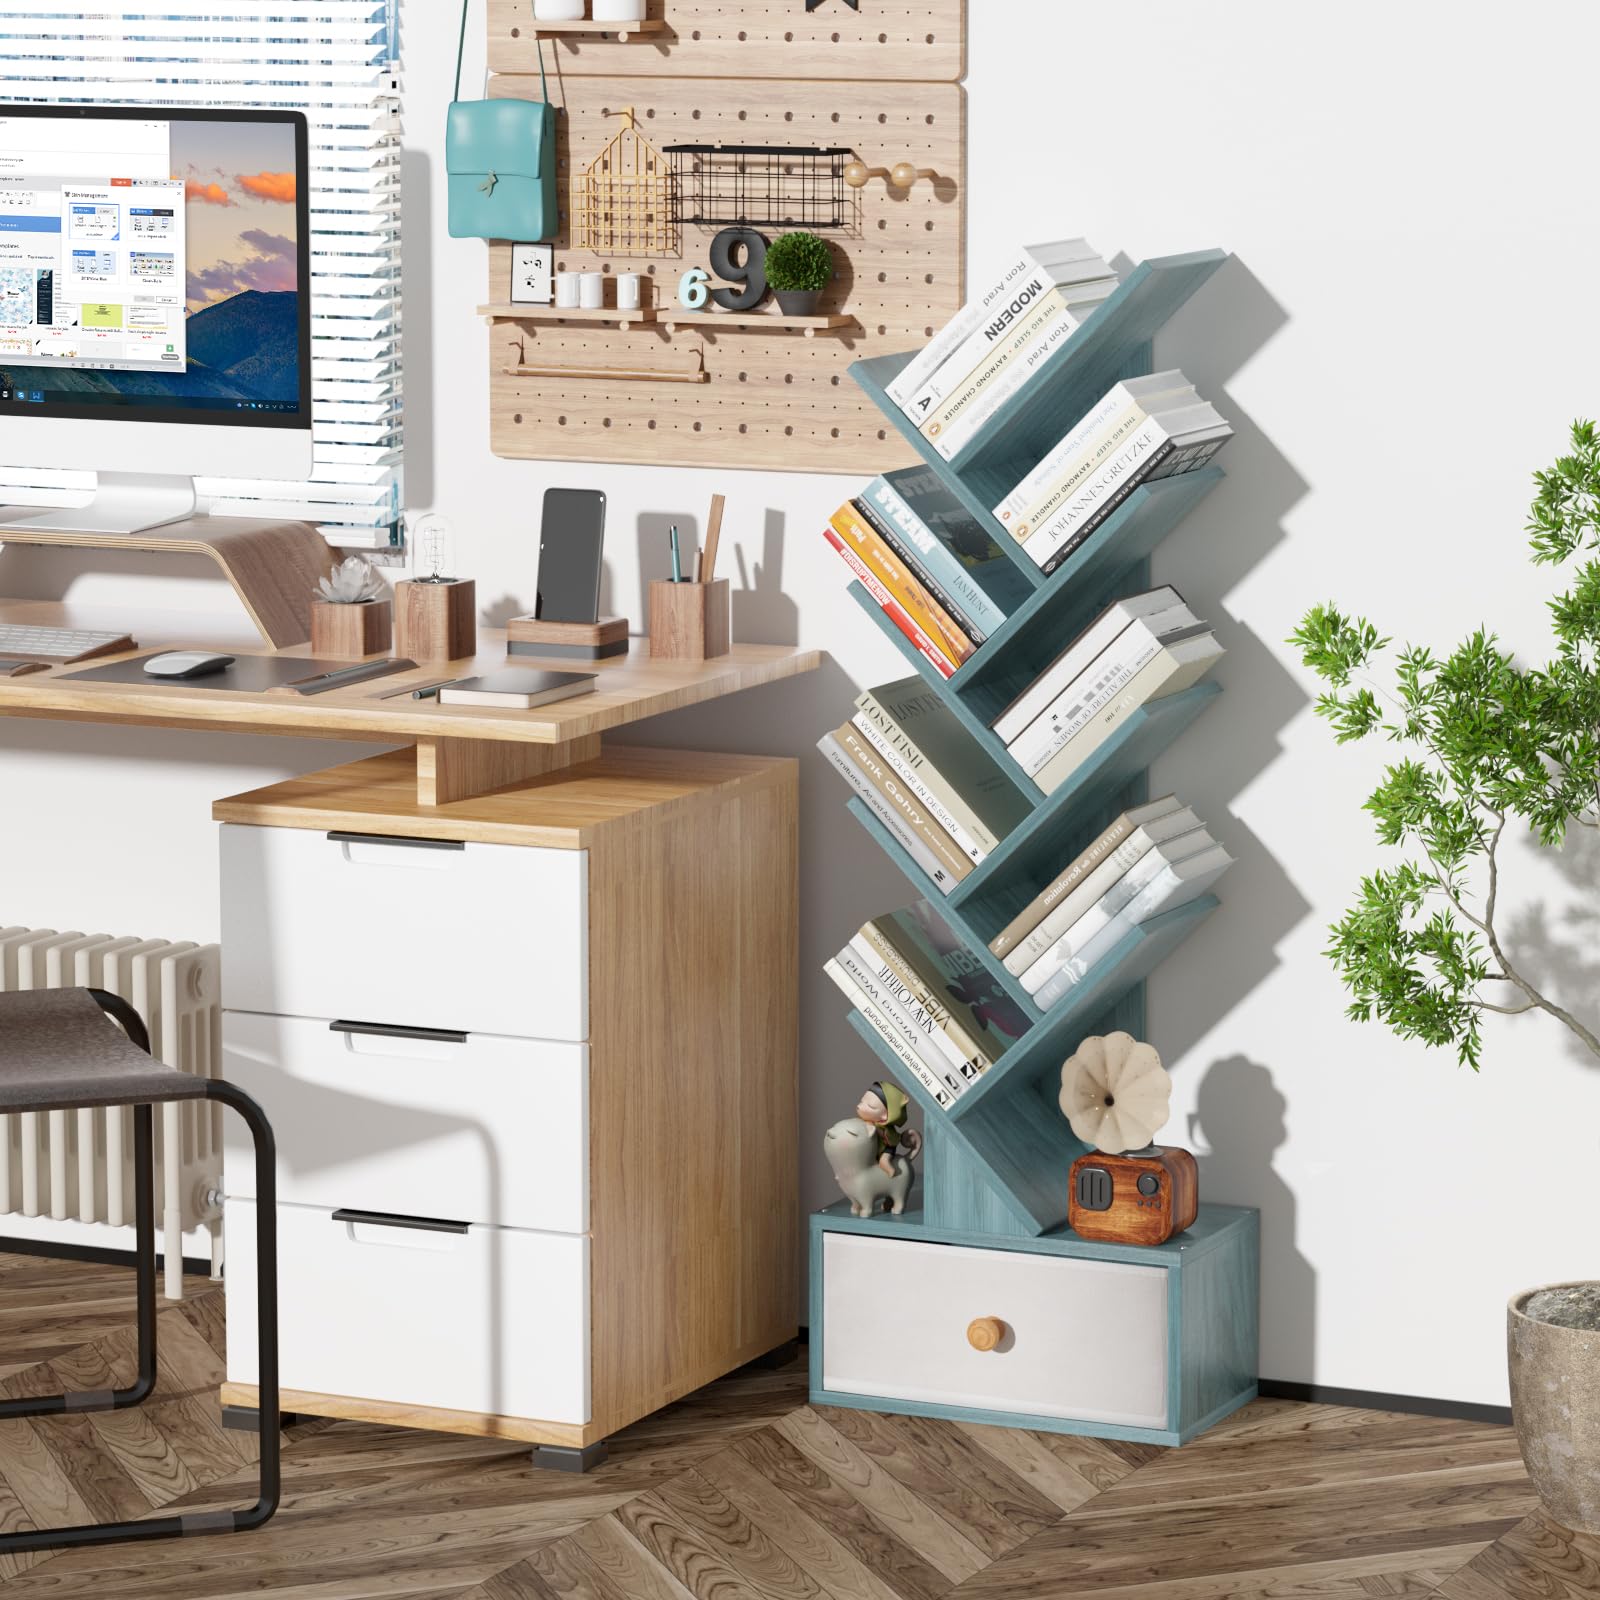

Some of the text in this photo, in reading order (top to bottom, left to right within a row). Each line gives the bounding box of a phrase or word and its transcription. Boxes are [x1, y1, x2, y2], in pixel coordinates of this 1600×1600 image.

[679, 268, 708, 308] 6
[710, 227, 767, 309] 9
[983, 261, 1026, 307] Ron Arad
[985, 280, 1042, 341] MODERN
[1027, 322, 1069, 366] Ron Arad
[944, 305, 1056, 421] THE BIG SLEEP RAYMOND CHANDLER
[917, 397, 931, 411] A
[1031, 417, 1136, 523] THE BIG SLEEP RAYMOND CHANDLER
[1048, 485, 1104, 541] JOHANNES
[876, 485, 938, 554] STEAM
[953, 575, 969, 593] IAN
[965, 589, 988, 615] HUNT
[838, 547, 891, 606] #DISRUPTMENOW
[913, 633, 928, 648] DAVID
[928, 649, 943, 664] SMITH
[1092, 682, 1117, 711] ALLURE
[1118, 669, 1133, 685] THE
[861, 698, 923, 768] LOST FISH
[1054, 720, 1082, 747] WOMEN
[1081, 709, 1091, 720] OF
[832, 752, 861, 788] Furniture,
[862, 789, 873, 799] Art
[871, 800, 884, 812] and
[882, 811, 912, 846] Accessories
[846, 736, 924, 824] Frank Gehry
[861, 720, 887, 751] WHITE
[887, 751, 917, 785] COLOR
[916, 785, 926, 796] IN
[926, 796, 958, 833] DESIGN
[846, 960, 917, 1045] Wrong World
[872, 933, 954, 1032] VIBE DRUM&BASS
[876, 966, 937, 1035] NEW YORKER
[863, 1007, 933, 1087] the velvet underground
